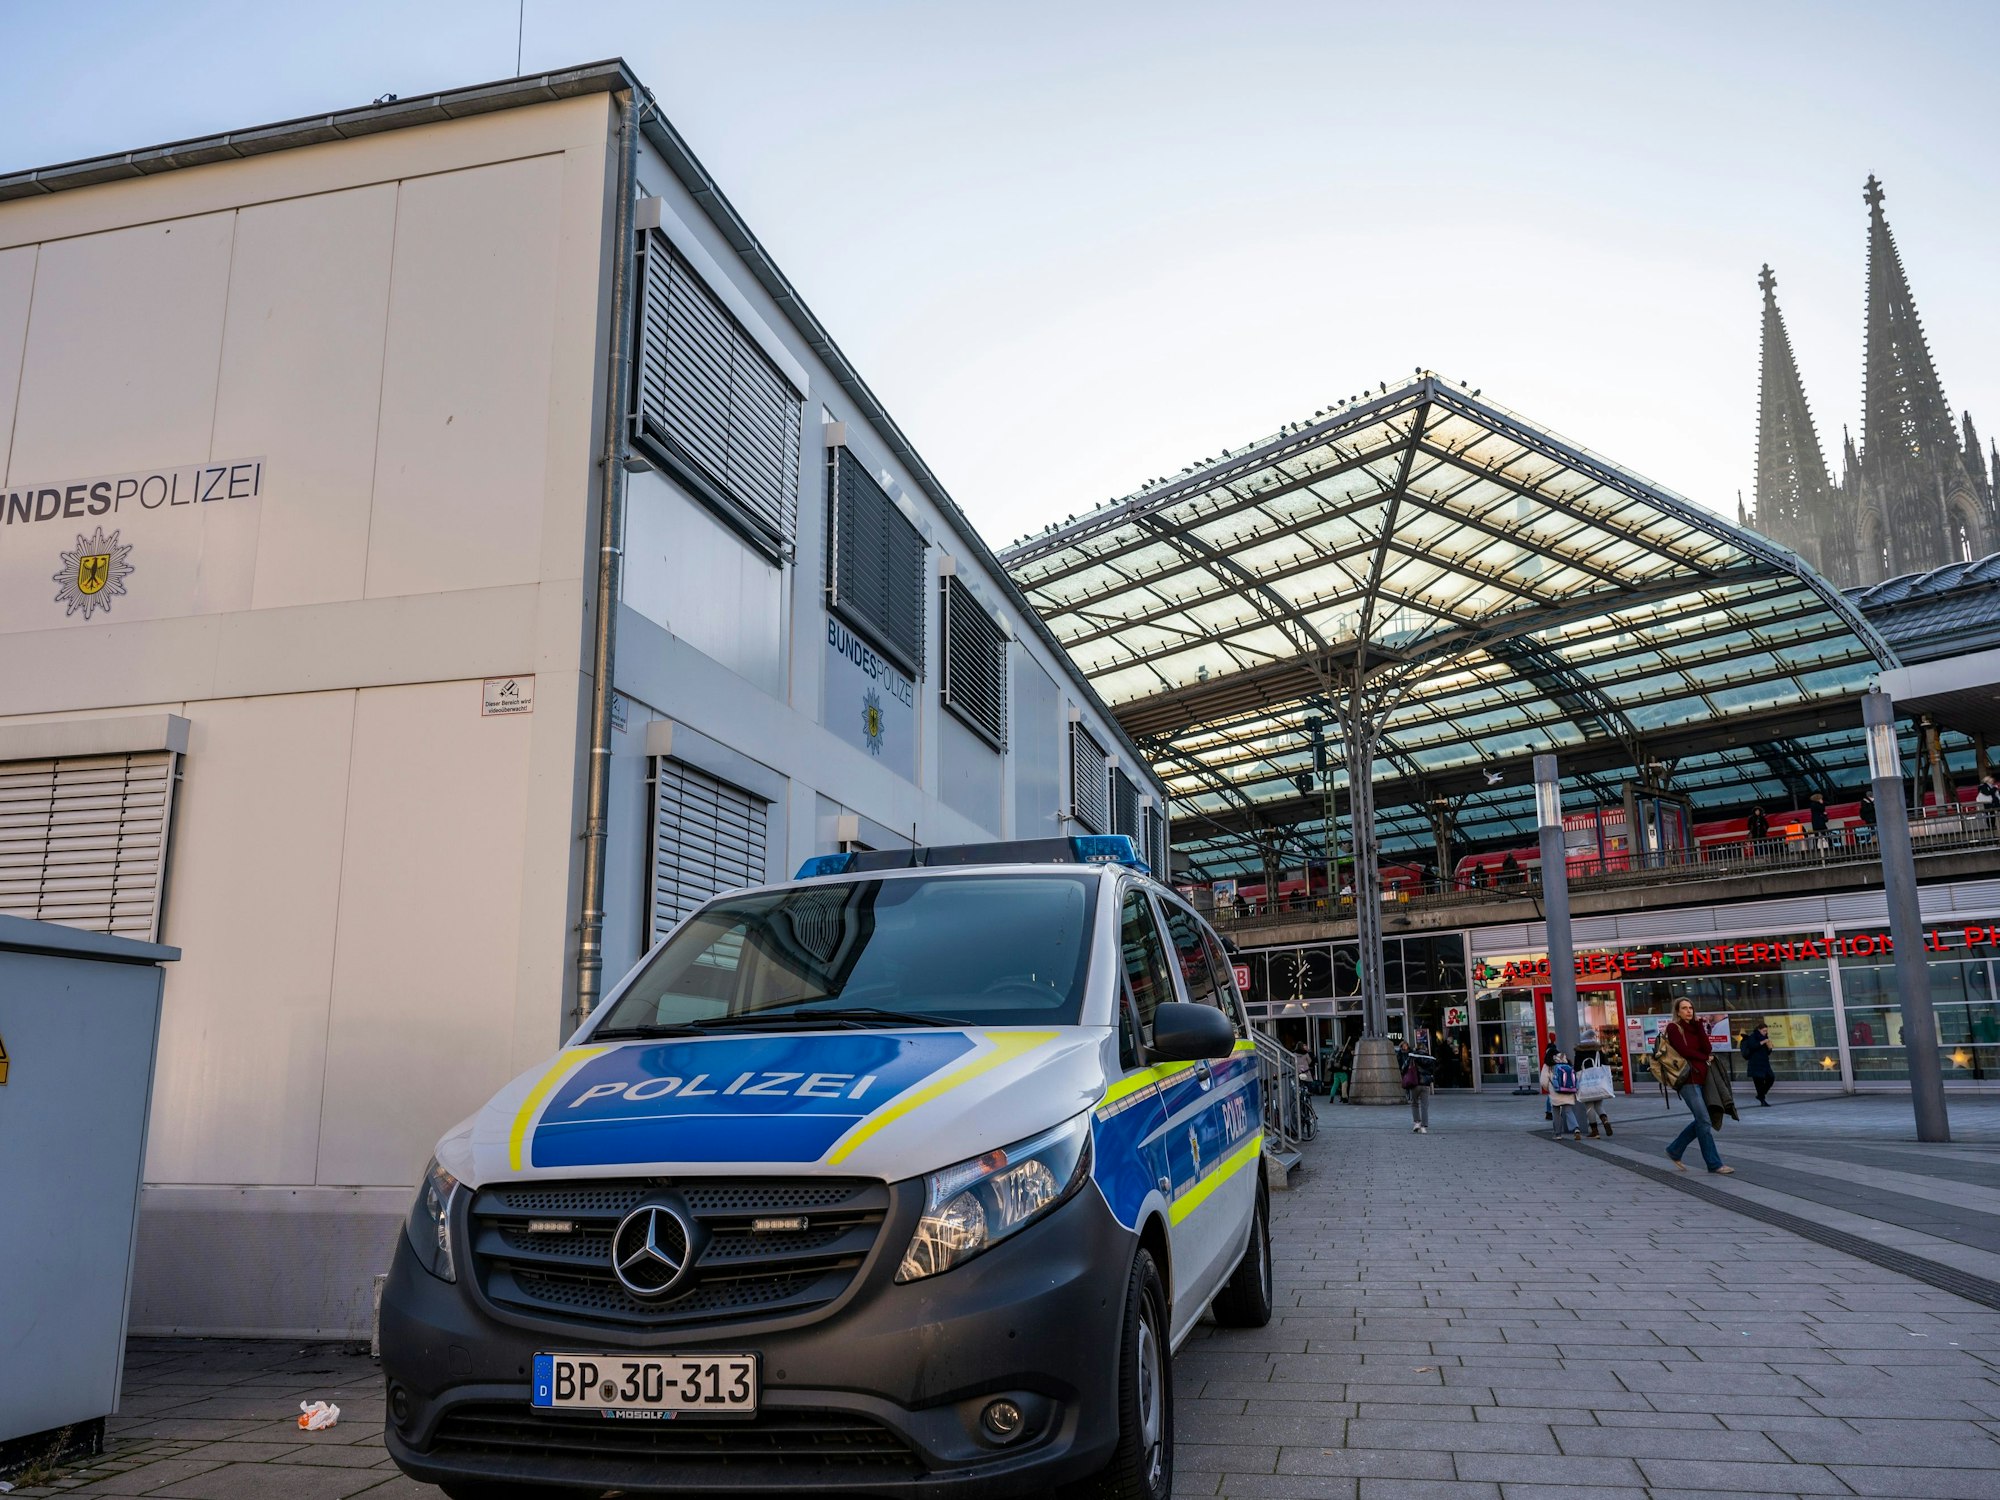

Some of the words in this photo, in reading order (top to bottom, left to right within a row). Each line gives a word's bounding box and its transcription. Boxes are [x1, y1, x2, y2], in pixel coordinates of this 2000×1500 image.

[0, 463, 260, 525] NDESPOLIZEI
[828, 618, 914, 709] BUNDESPOLIZEI
[1503, 952, 1639, 979] APOHEKE
[1683, 930, 1950, 968] INTERNATIONL
[568, 1072, 878, 1108] POLIZEI
[1222, 1095, 1248, 1145] POLIZEI
[539, 1385, 548, 1397] D
[616, 1410, 664, 1419] MOSOLF
